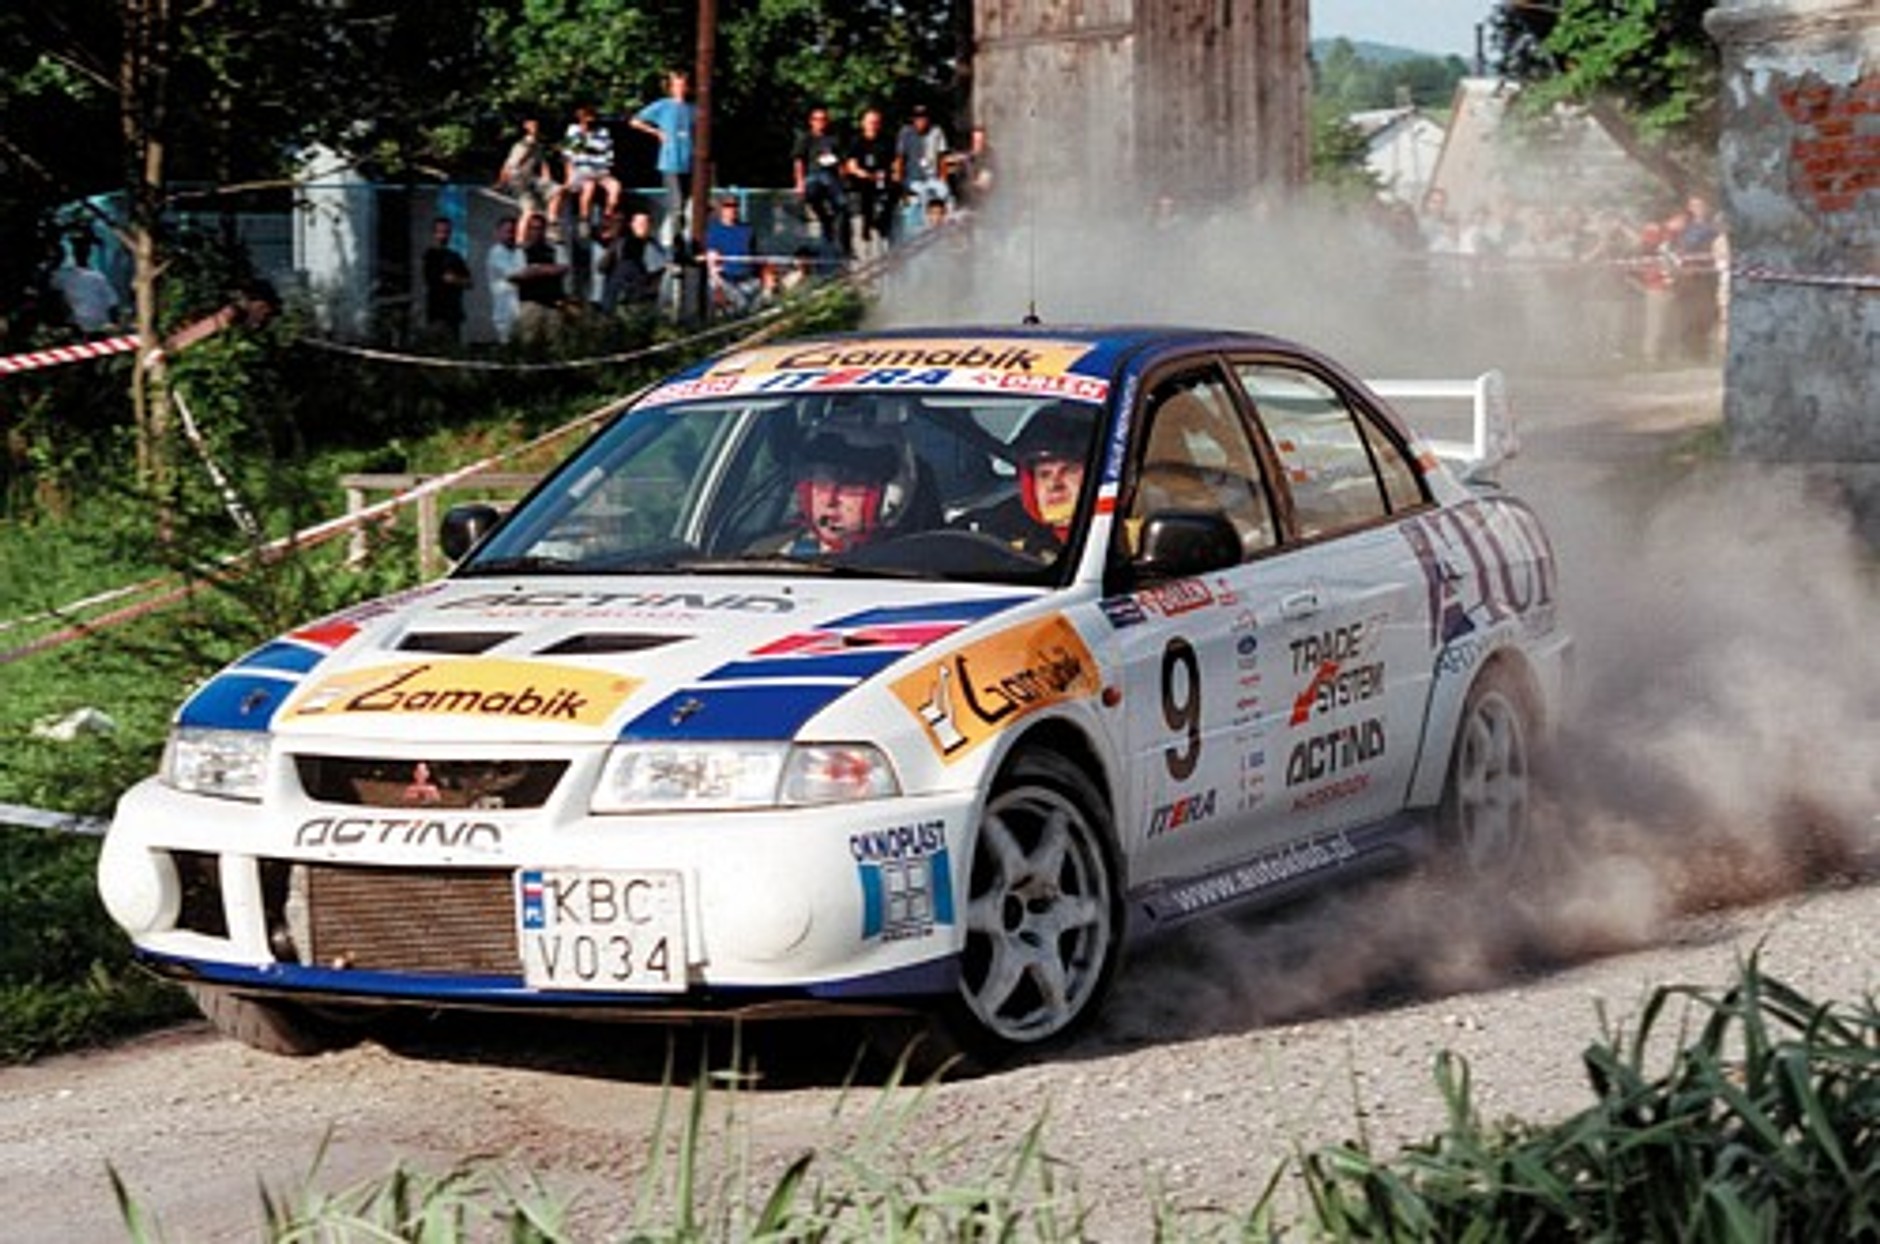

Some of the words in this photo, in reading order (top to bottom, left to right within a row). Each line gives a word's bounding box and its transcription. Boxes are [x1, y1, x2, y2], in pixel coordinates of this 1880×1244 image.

[1288, 622, 1363, 676] TRADE
[1160, 635, 1203, 781] 9
[1315, 660, 1386, 715] SYSTEM
[849, 818, 945, 862] OKNOPLAST
[554, 877, 653, 925] KBC
[536, 934, 671, 982] V034
